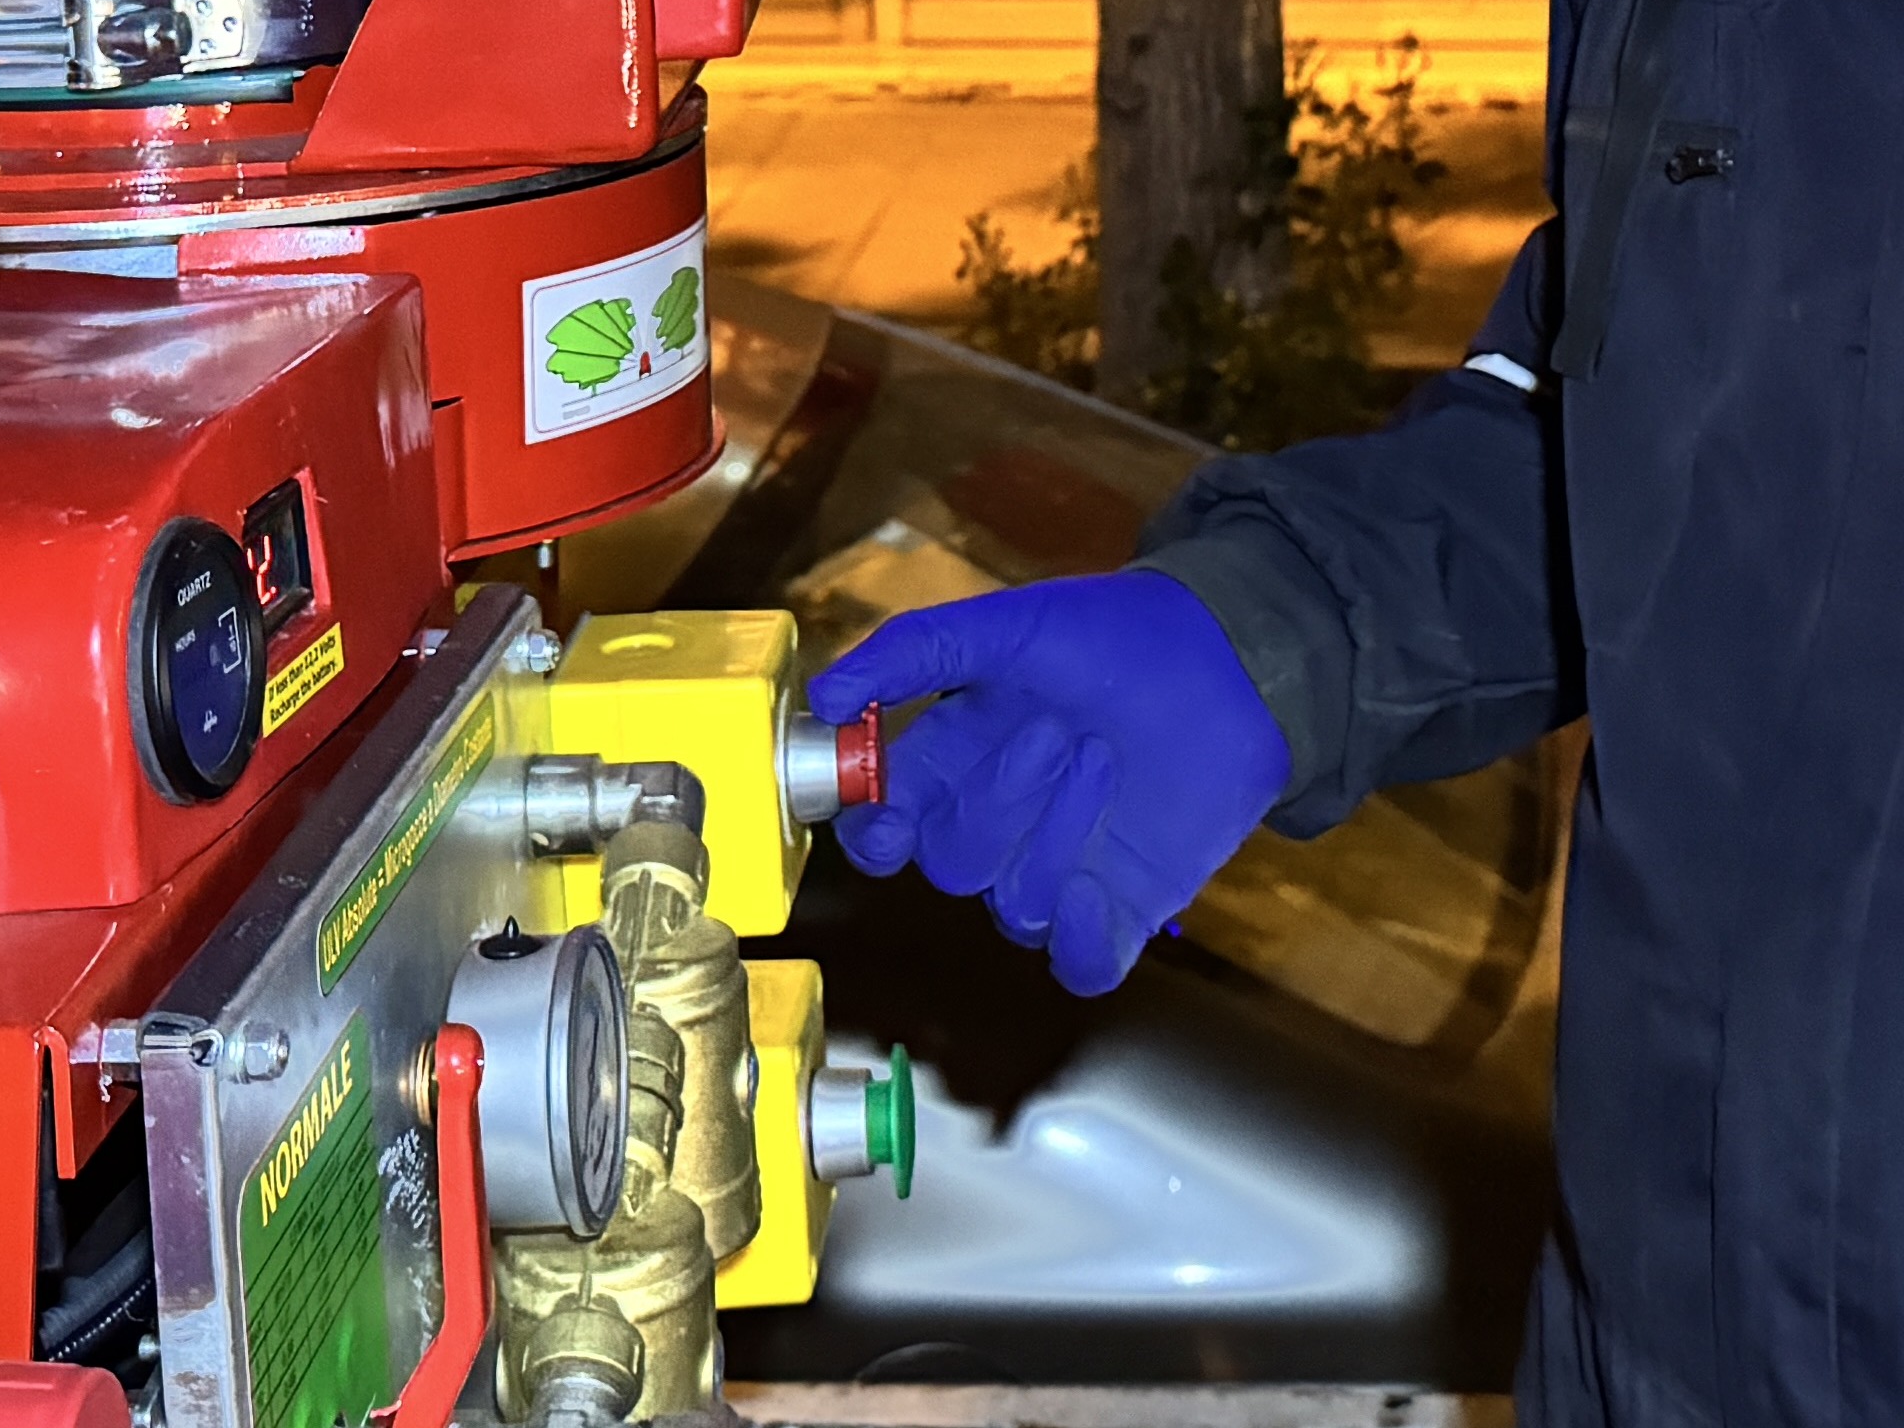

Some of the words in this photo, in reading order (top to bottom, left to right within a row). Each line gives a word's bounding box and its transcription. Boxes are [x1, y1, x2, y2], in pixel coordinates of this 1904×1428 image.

[177, 571, 211, 606] QUARTZ
[341, 875, 378, 948] Absolute
[260, 1039, 353, 1227] NORMALE
